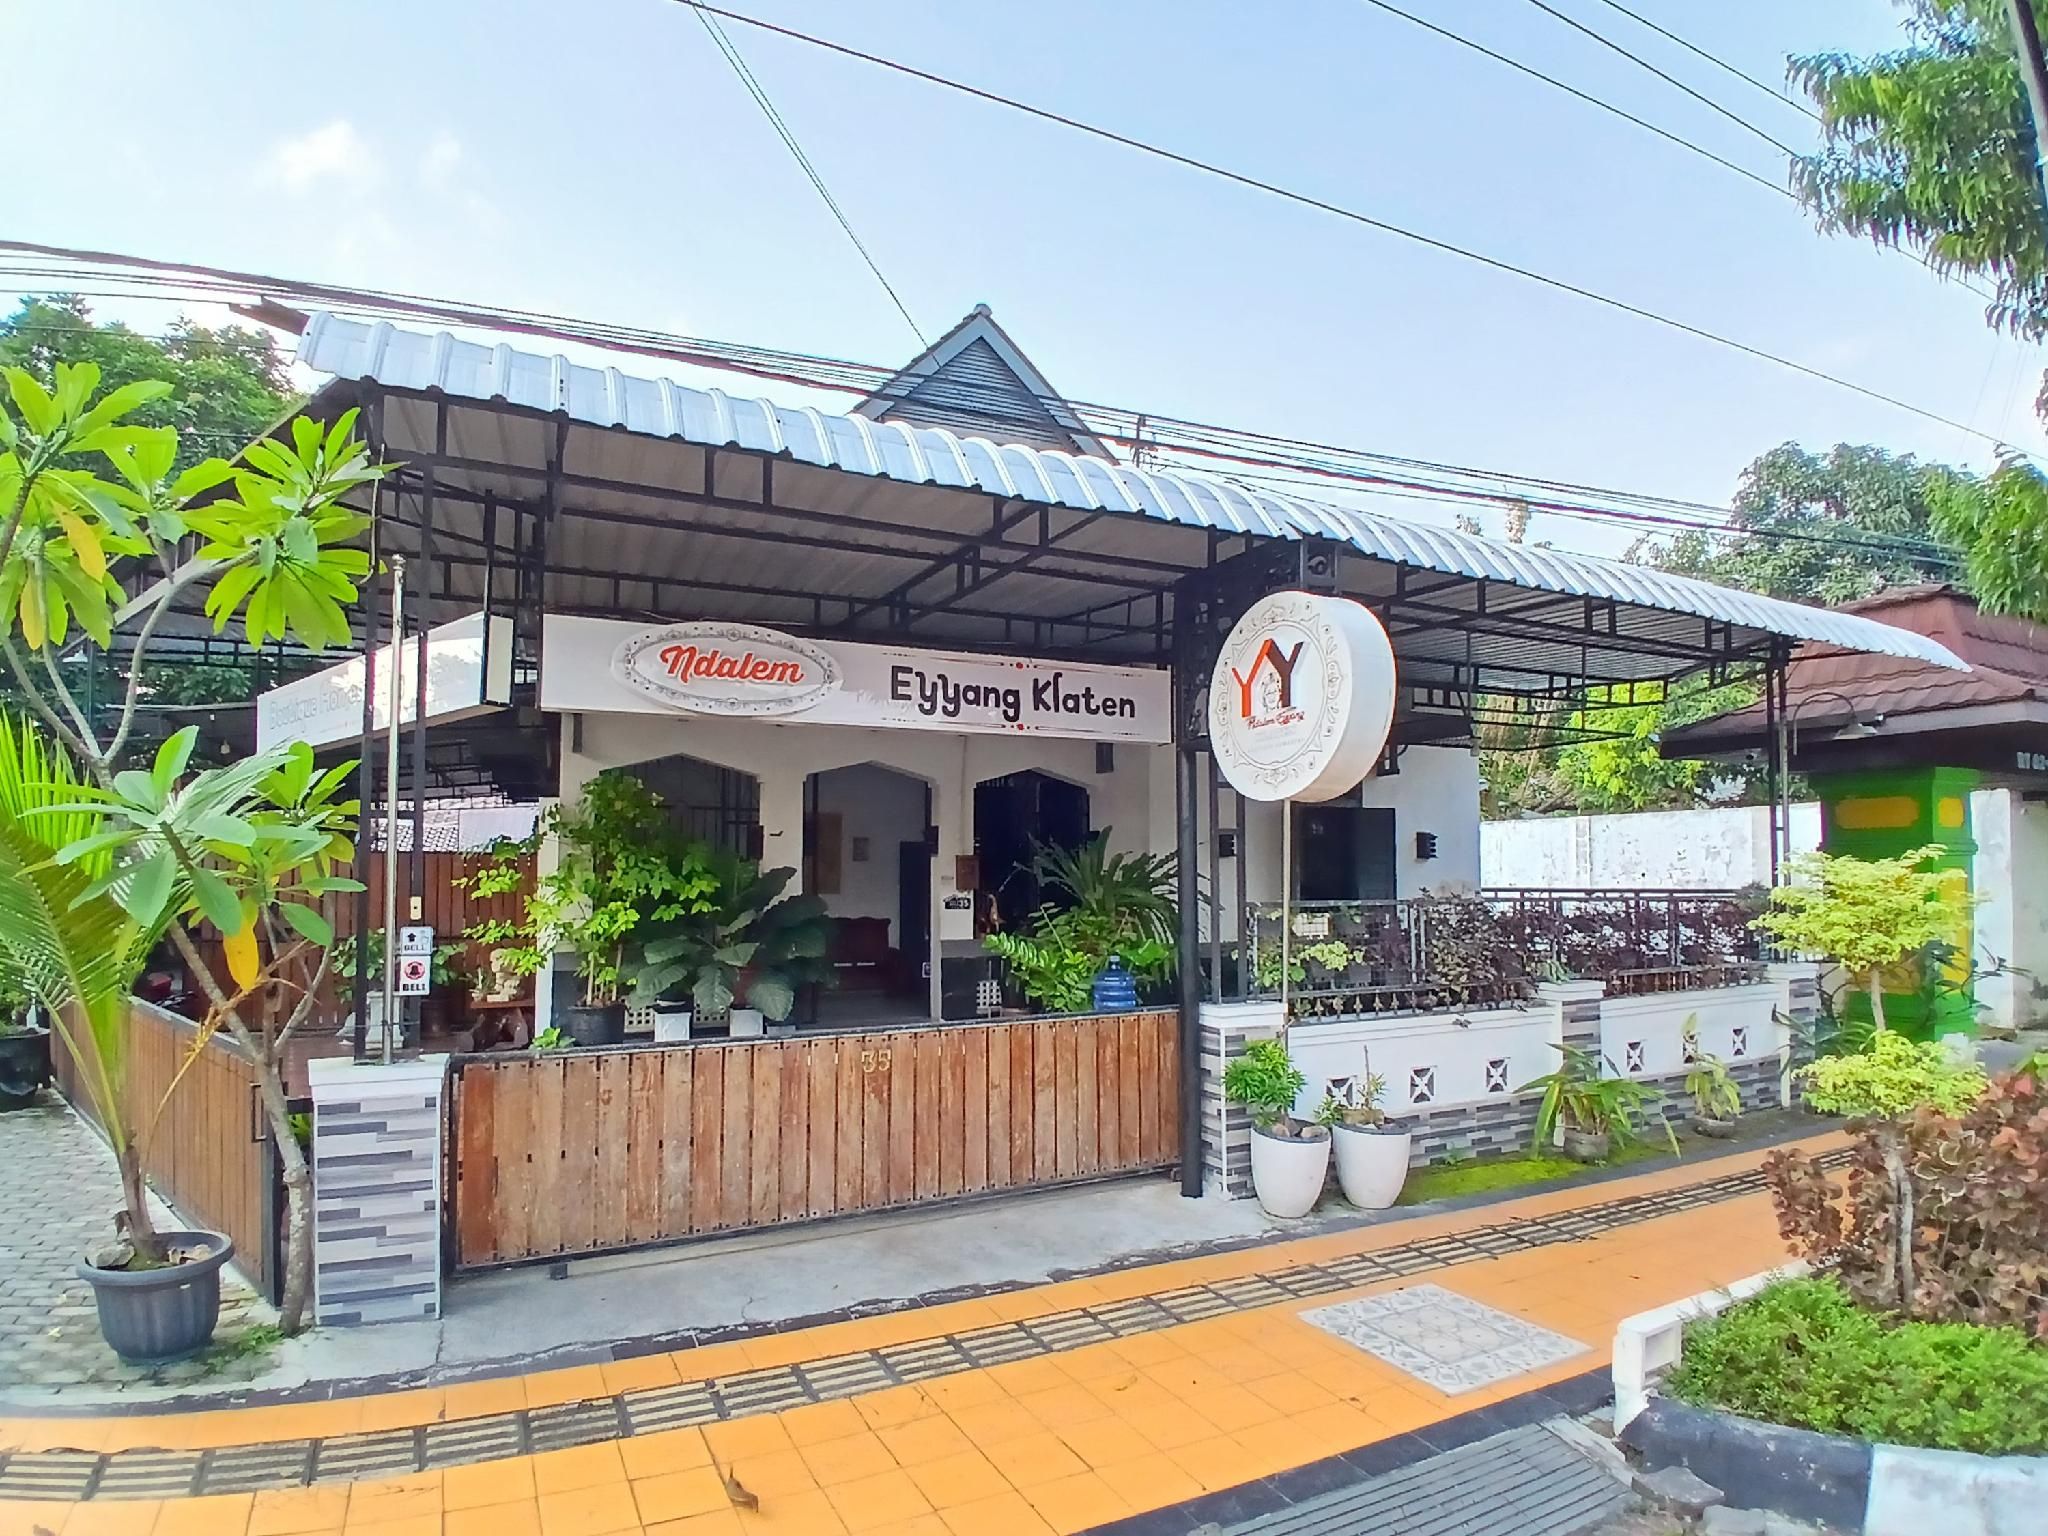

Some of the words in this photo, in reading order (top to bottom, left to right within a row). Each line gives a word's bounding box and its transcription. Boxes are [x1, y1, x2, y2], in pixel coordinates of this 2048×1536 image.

[659, 645, 804, 684] Ndalem
[890, 665, 1021, 723] Eyyang
[1032, 671, 1136, 718] Klaten
[862, 1049, 891, 1072] 35
